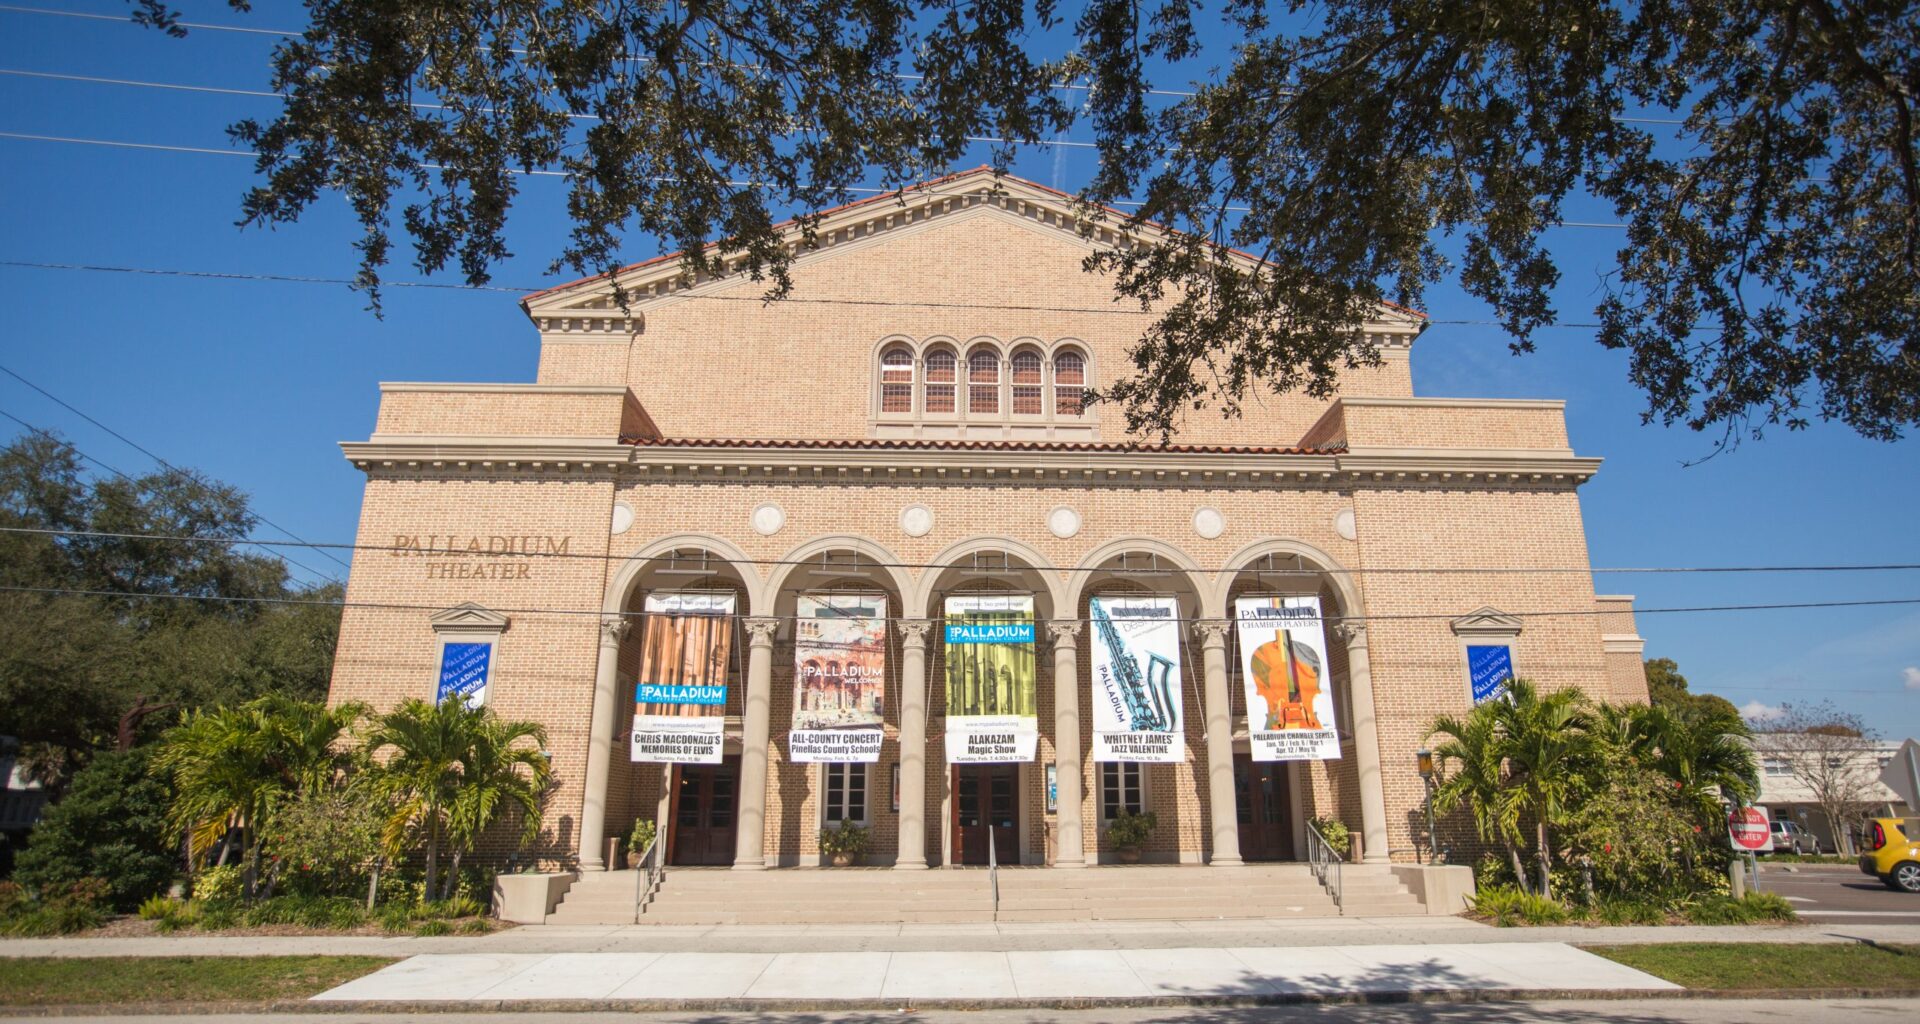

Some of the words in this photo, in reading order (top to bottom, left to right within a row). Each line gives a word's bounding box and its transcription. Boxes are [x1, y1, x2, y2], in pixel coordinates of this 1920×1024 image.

[389, 535, 572, 557] PALLADIUM
[426, 562, 531, 579] THEATER
[1241, 609, 1317, 619] PALLADIUM
[1284, 620, 1318, 628] PLAYERS
[954, 627, 1029, 637] PALLADIUM
[444, 652, 486, 681] PALLADIUM
[807, 666, 882, 677] PALLADIUM
[1473, 655, 1507, 682] PALLADIUM
[441, 665, 485, 695] PALLADIUM
[1474, 667, 1509, 695] PALLADIUM
[645, 686, 723, 699] PALLADIUM
[1099, 664, 1126, 723] PALLADIUM
[634, 734, 661, 743] CHRIS
[663, 734, 720, 745] MACDONALD'S
[792, 734, 841, 743] ALL-COUNTY
[843, 734, 881, 744] CONCERT
[968, 734, 1015, 744] ALAKAZAM
[1103, 734, 1143, 744] WHITNEY
[1145, 734, 1174, 744] JAMES'
[1253, 732, 1286, 740] PALLADIUM
[1287, 732, 1313, 740] CHAMBER
[641, 745, 682, 754] MEMORIES
[683, 746, 693, 754] OF
[694, 746, 714, 755] ELVIS
[791, 744, 821, 753] Pinellas
[823, 745, 849, 754] County
[851, 744, 880, 753] Schools
[968, 745, 992, 755] Magic
[994, 745, 1016, 753] Show
[1111, 745, 1127, 753] JAZZ
[1129, 745, 1168, 753] VALENTINE
